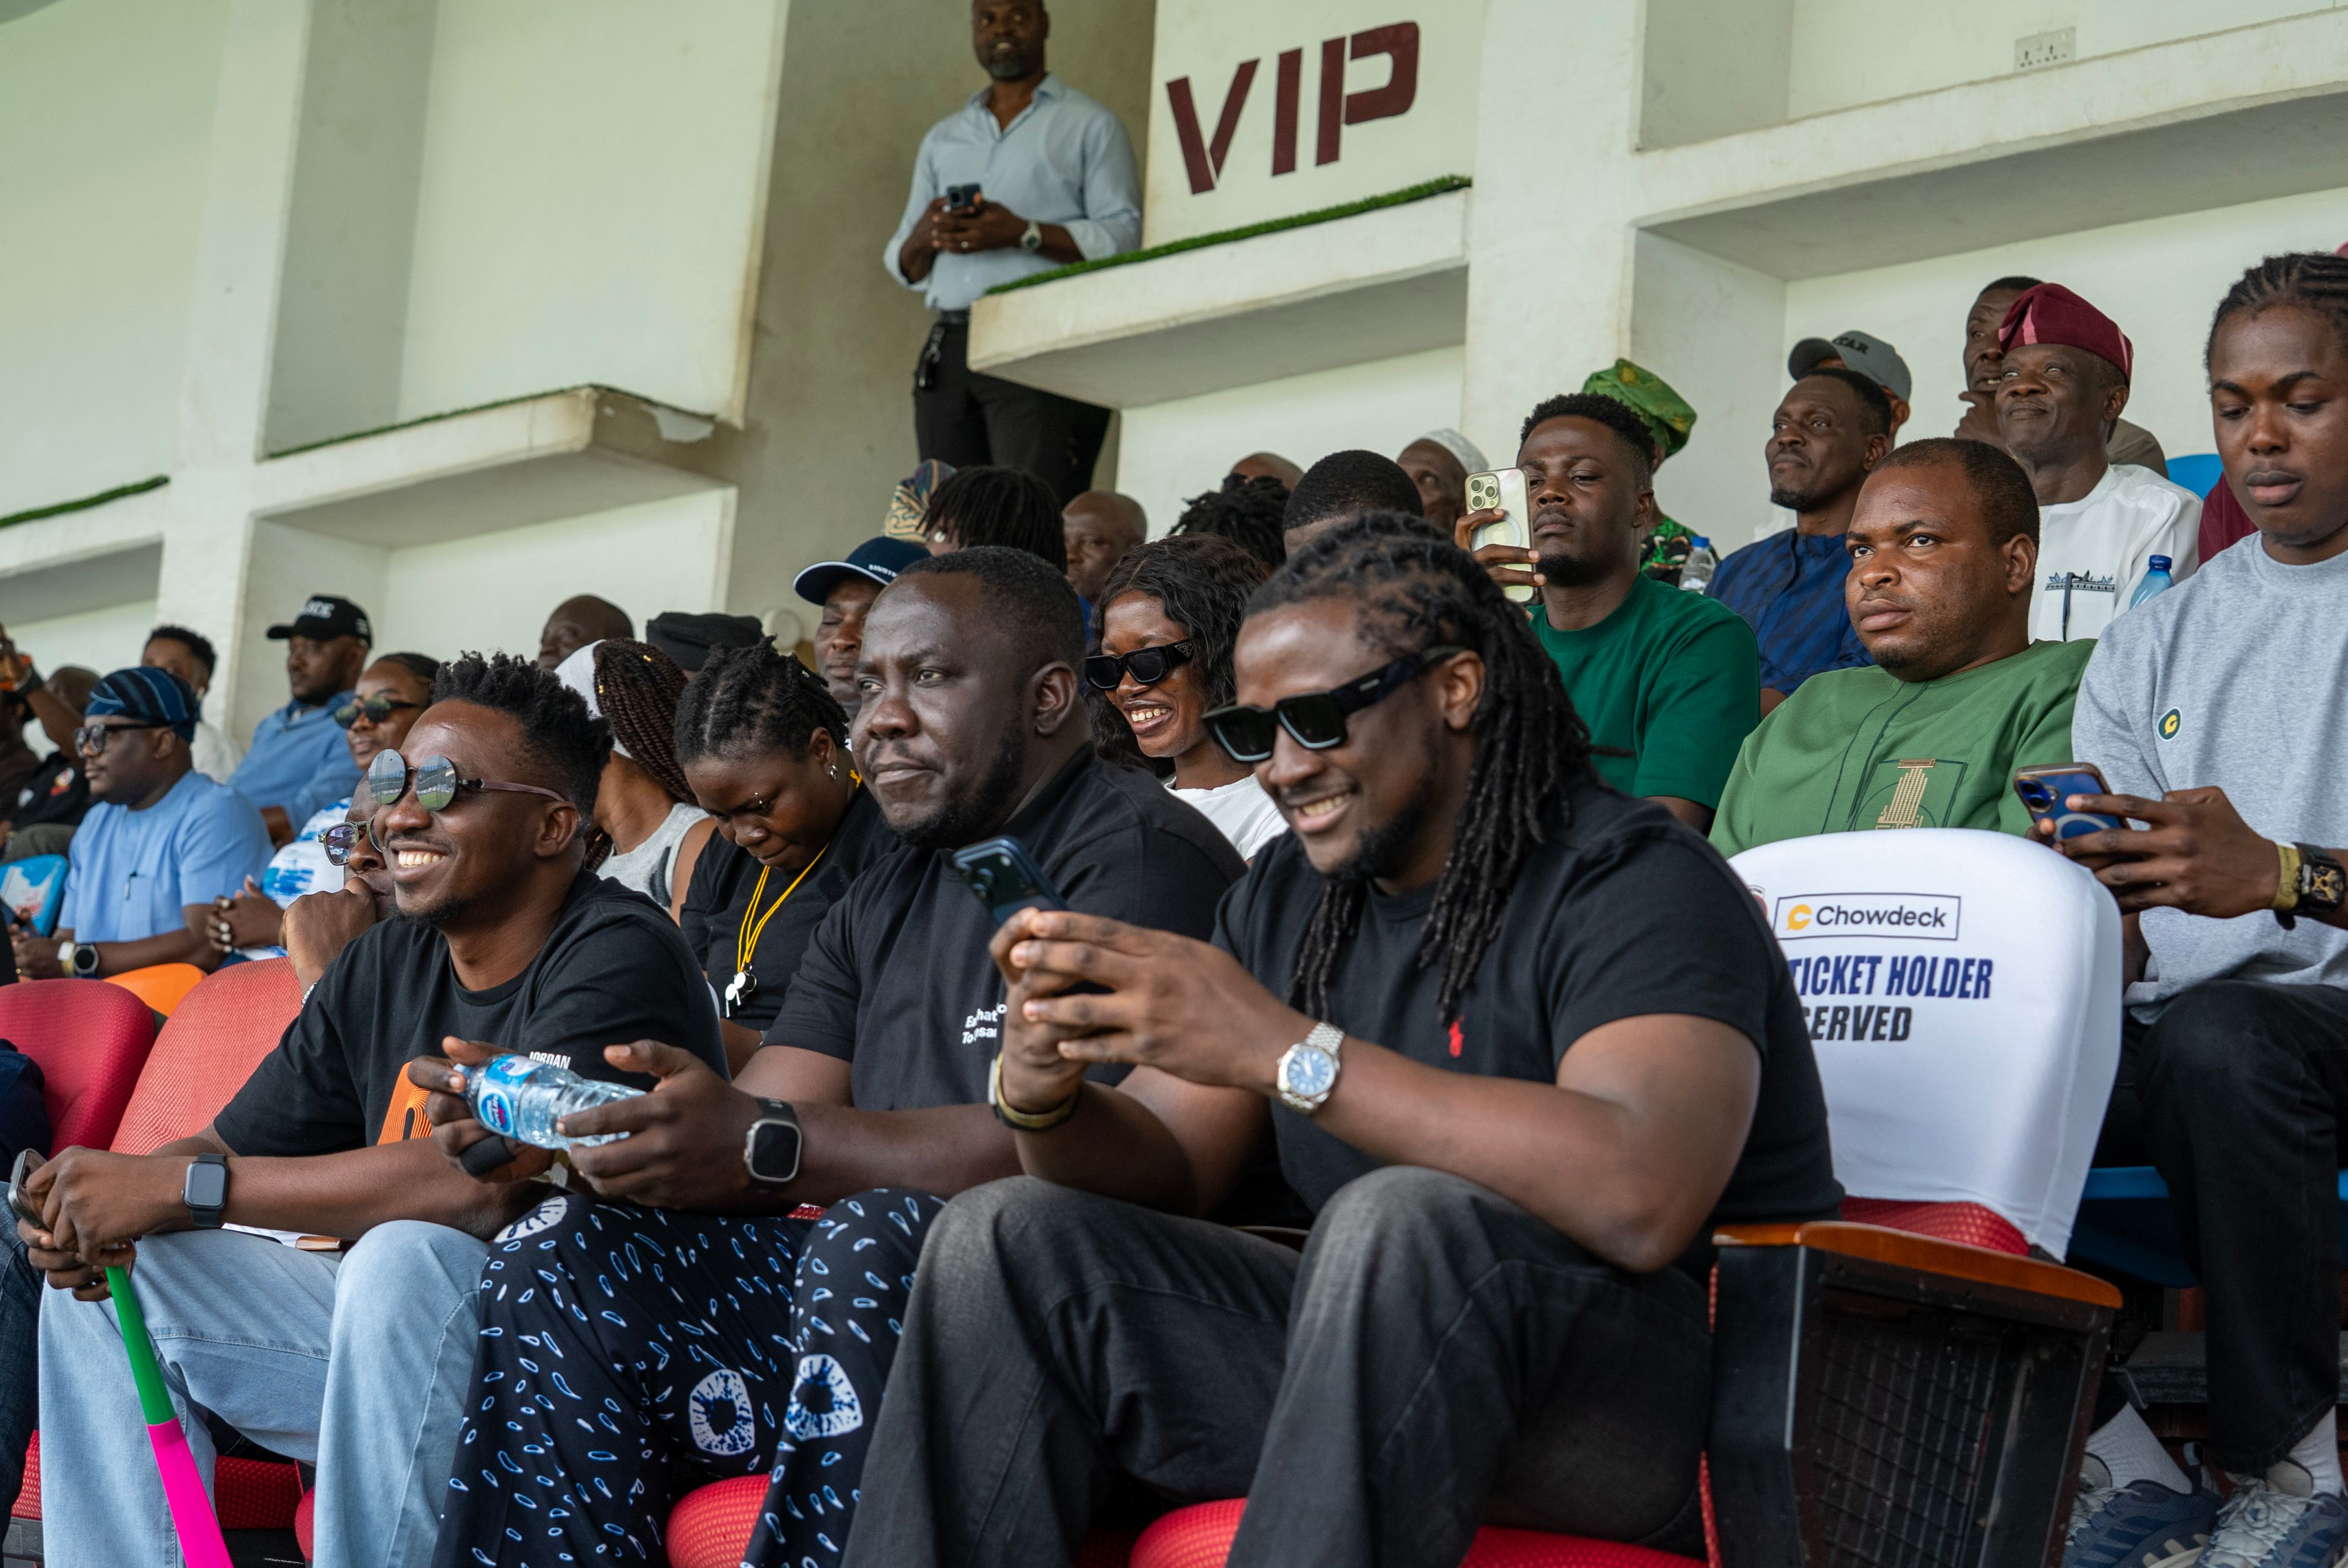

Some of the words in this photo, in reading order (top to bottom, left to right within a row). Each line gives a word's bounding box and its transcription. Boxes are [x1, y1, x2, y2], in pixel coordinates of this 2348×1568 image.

[1166, 20, 1420, 195] VIP
[1816, 905, 1947, 928] Chowdeck
[1788, 955, 1883, 996] TICKET
[1884, 955, 1994, 999] HOLDER
